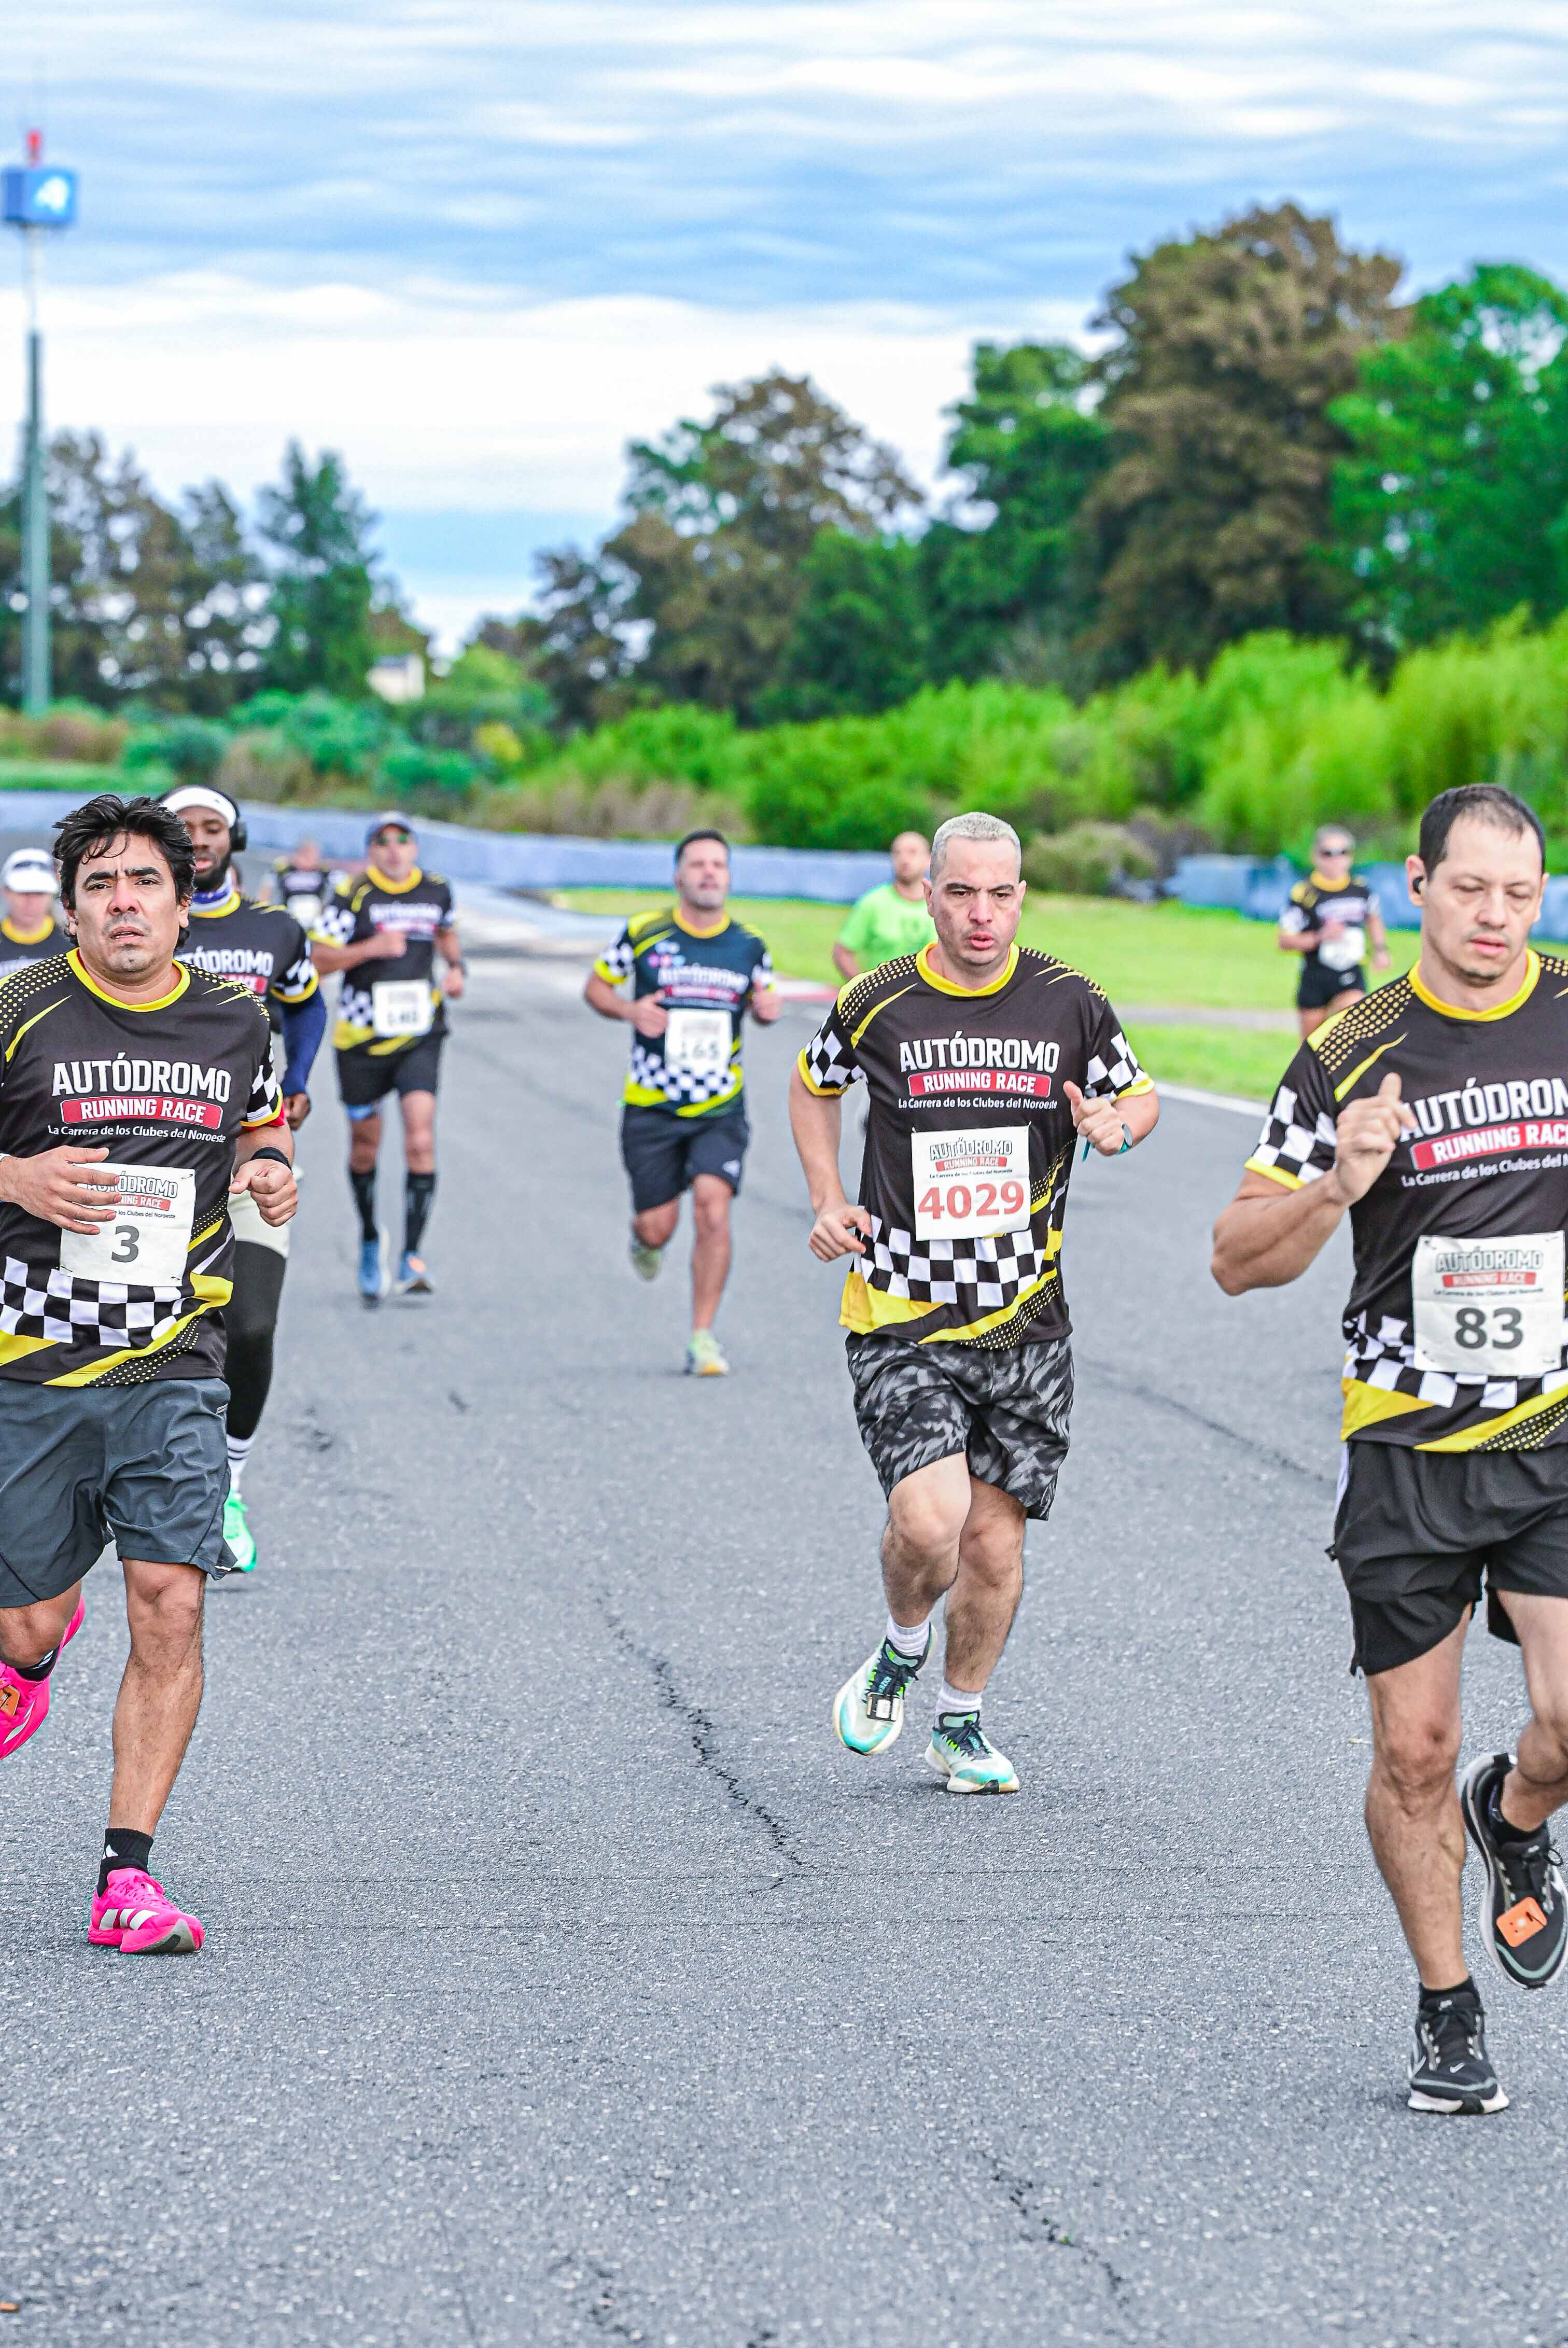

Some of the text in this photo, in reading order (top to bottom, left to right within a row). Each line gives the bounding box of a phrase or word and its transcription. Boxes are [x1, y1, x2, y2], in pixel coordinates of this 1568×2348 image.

[899, 1030, 1060, 1073] AUTÓDROMO
[52, 1052, 231, 1102] AUTÓDROMO
[923, 1072, 1037, 1094] RUNNING RACE
[80, 1099, 206, 1123] RUNNING RACE
[898, 1097, 1057, 1109] La Carrera de los Clubes del Noroeste
[1399, 1077, 1568, 1142] AUTÓDROM
[48, 1125, 226, 1143] La Carrera de los Clubes del Noroeste
[930, 1137, 1012, 1161] AUTÓDROMO
[1431, 1123, 1568, 1164] RUNNING RAC
[944, 1156, 999, 1170] RUNNING RACE
[1401, 1174, 1416, 1187] La
[1416, 1170, 1461, 1186] Carrera
[1461, 1165, 1478, 1179] de
[1478, 1163, 1499, 1177] los
[1499, 1157, 1541, 1173] Clubes
[1542, 1153, 1561, 1168] del
[141, 1196, 162, 1208] RACE
[918, 1180, 1024, 1220] 4029
[111, 1225, 139, 1263] 3
[1435, 1246, 1544, 1273] AUTÓDROMO
[1454, 1307, 1524, 1349] 83
